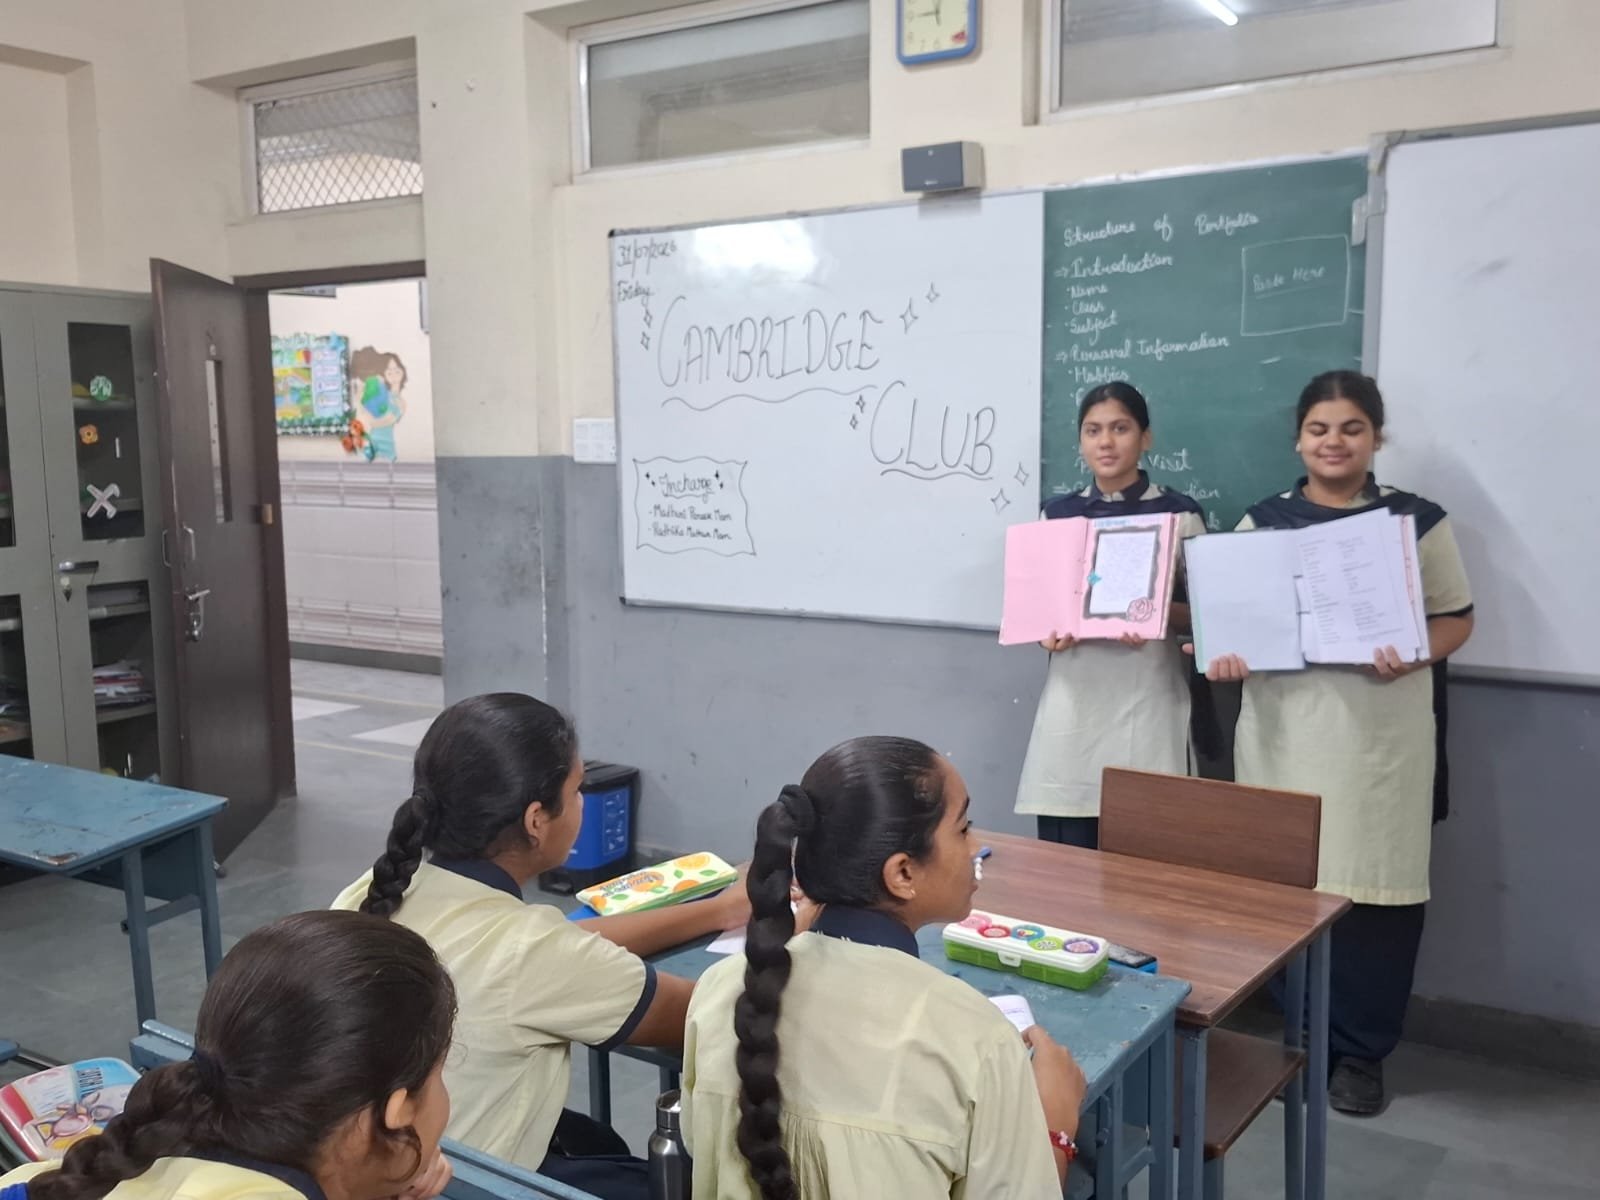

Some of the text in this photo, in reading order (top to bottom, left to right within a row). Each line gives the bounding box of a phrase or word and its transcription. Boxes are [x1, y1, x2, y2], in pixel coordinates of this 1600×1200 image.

[1063, 212, 1260, 248] Structure of Portfolio
[1070, 253, 1174, 279] Introduction
[616, 280, 656, 307] Friday
[1070, 283, 1109, 299] Name
[657, 295, 885, 388] CAMBRIDGE
[1069, 309, 1118, 346] Subject
[1136, 332, 1230, 361] Information
[1074, 366, 1130, 384] Hobbies
[869, 380, 996, 476] CLUB
[658, 472, 716, 504] Incharge
